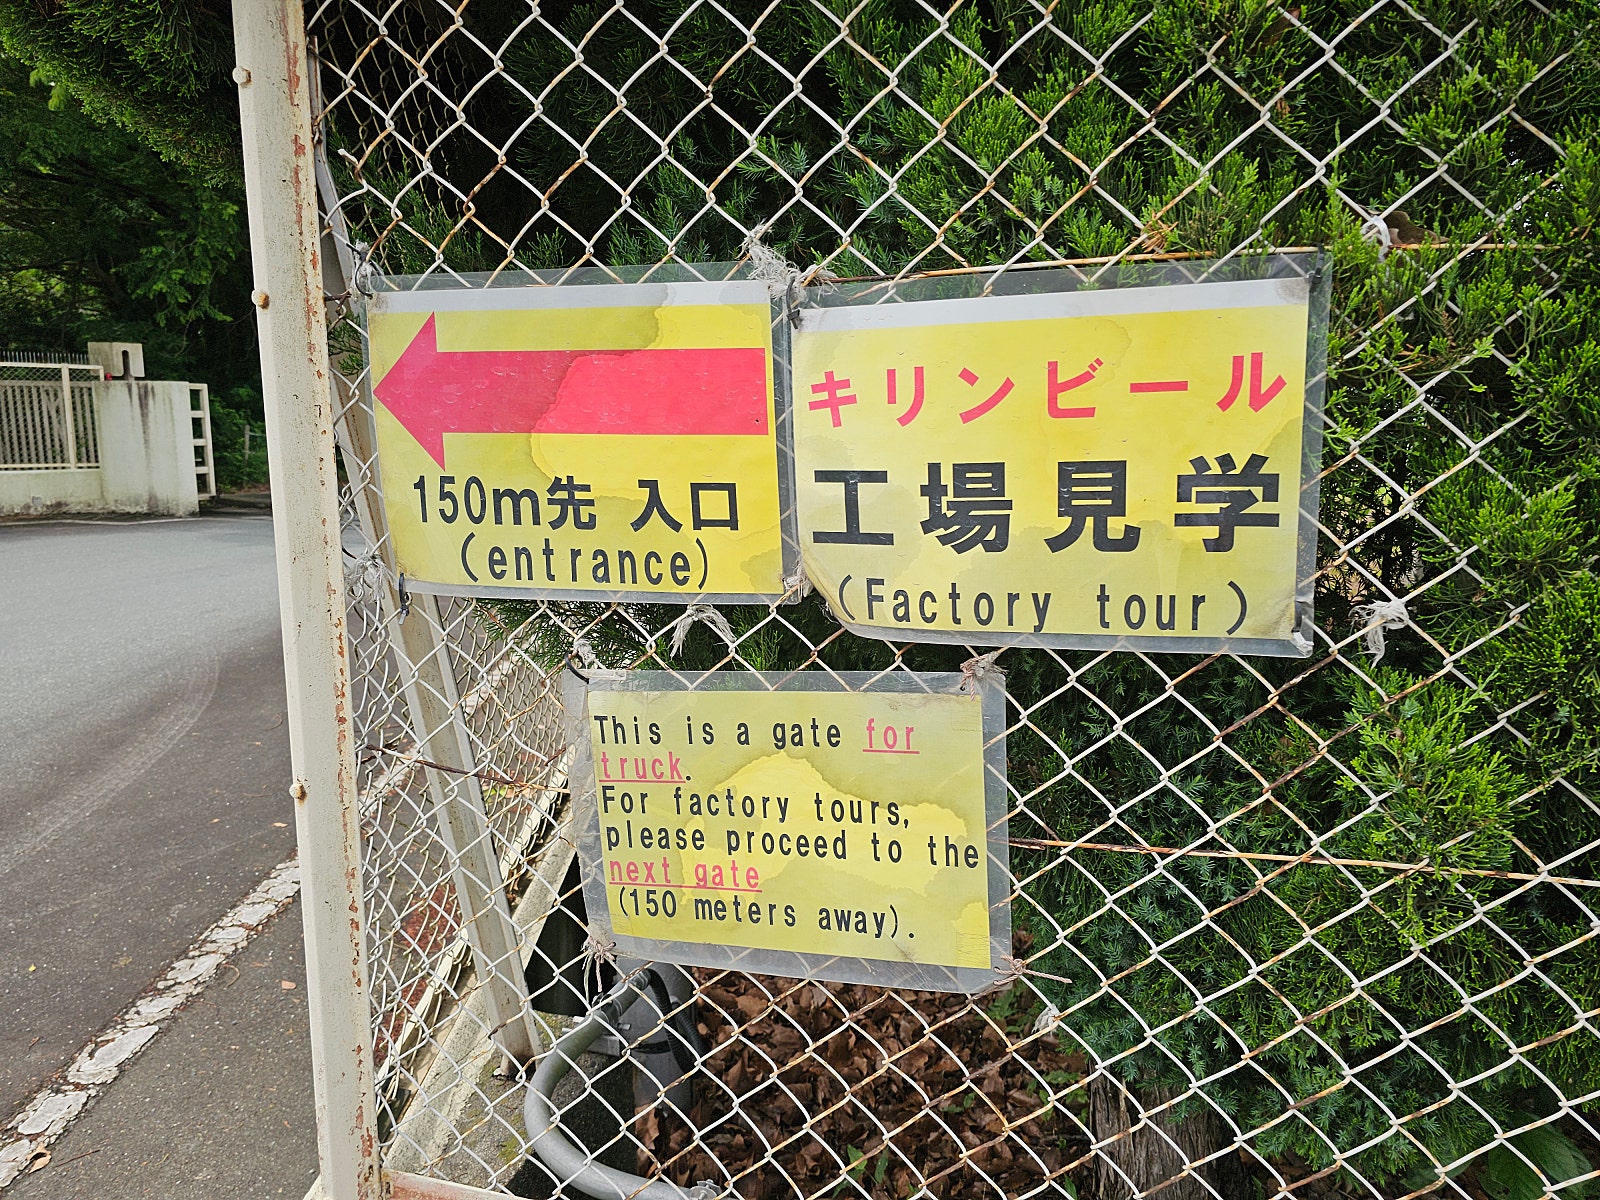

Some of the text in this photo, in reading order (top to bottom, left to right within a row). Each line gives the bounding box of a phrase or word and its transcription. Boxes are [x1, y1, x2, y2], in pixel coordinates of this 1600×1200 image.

[808, 352, 1287, 428] キリンビール
[413, 475, 739, 532] 150m先 入口
[812, 453, 1281, 555] 工場見学
[461, 532, 708, 590] (entrance)
[838, 575, 1052, 633] (Factory
[593, 715, 915, 750] This is a gate for
[600, 751, 692, 781] truck.
[601, 785, 909, 830] For factory tours,
[605, 820, 979, 869] please proceed to the
[608, 856, 761, 889] next gate
[619, 886, 915, 939] (150 meters away).
